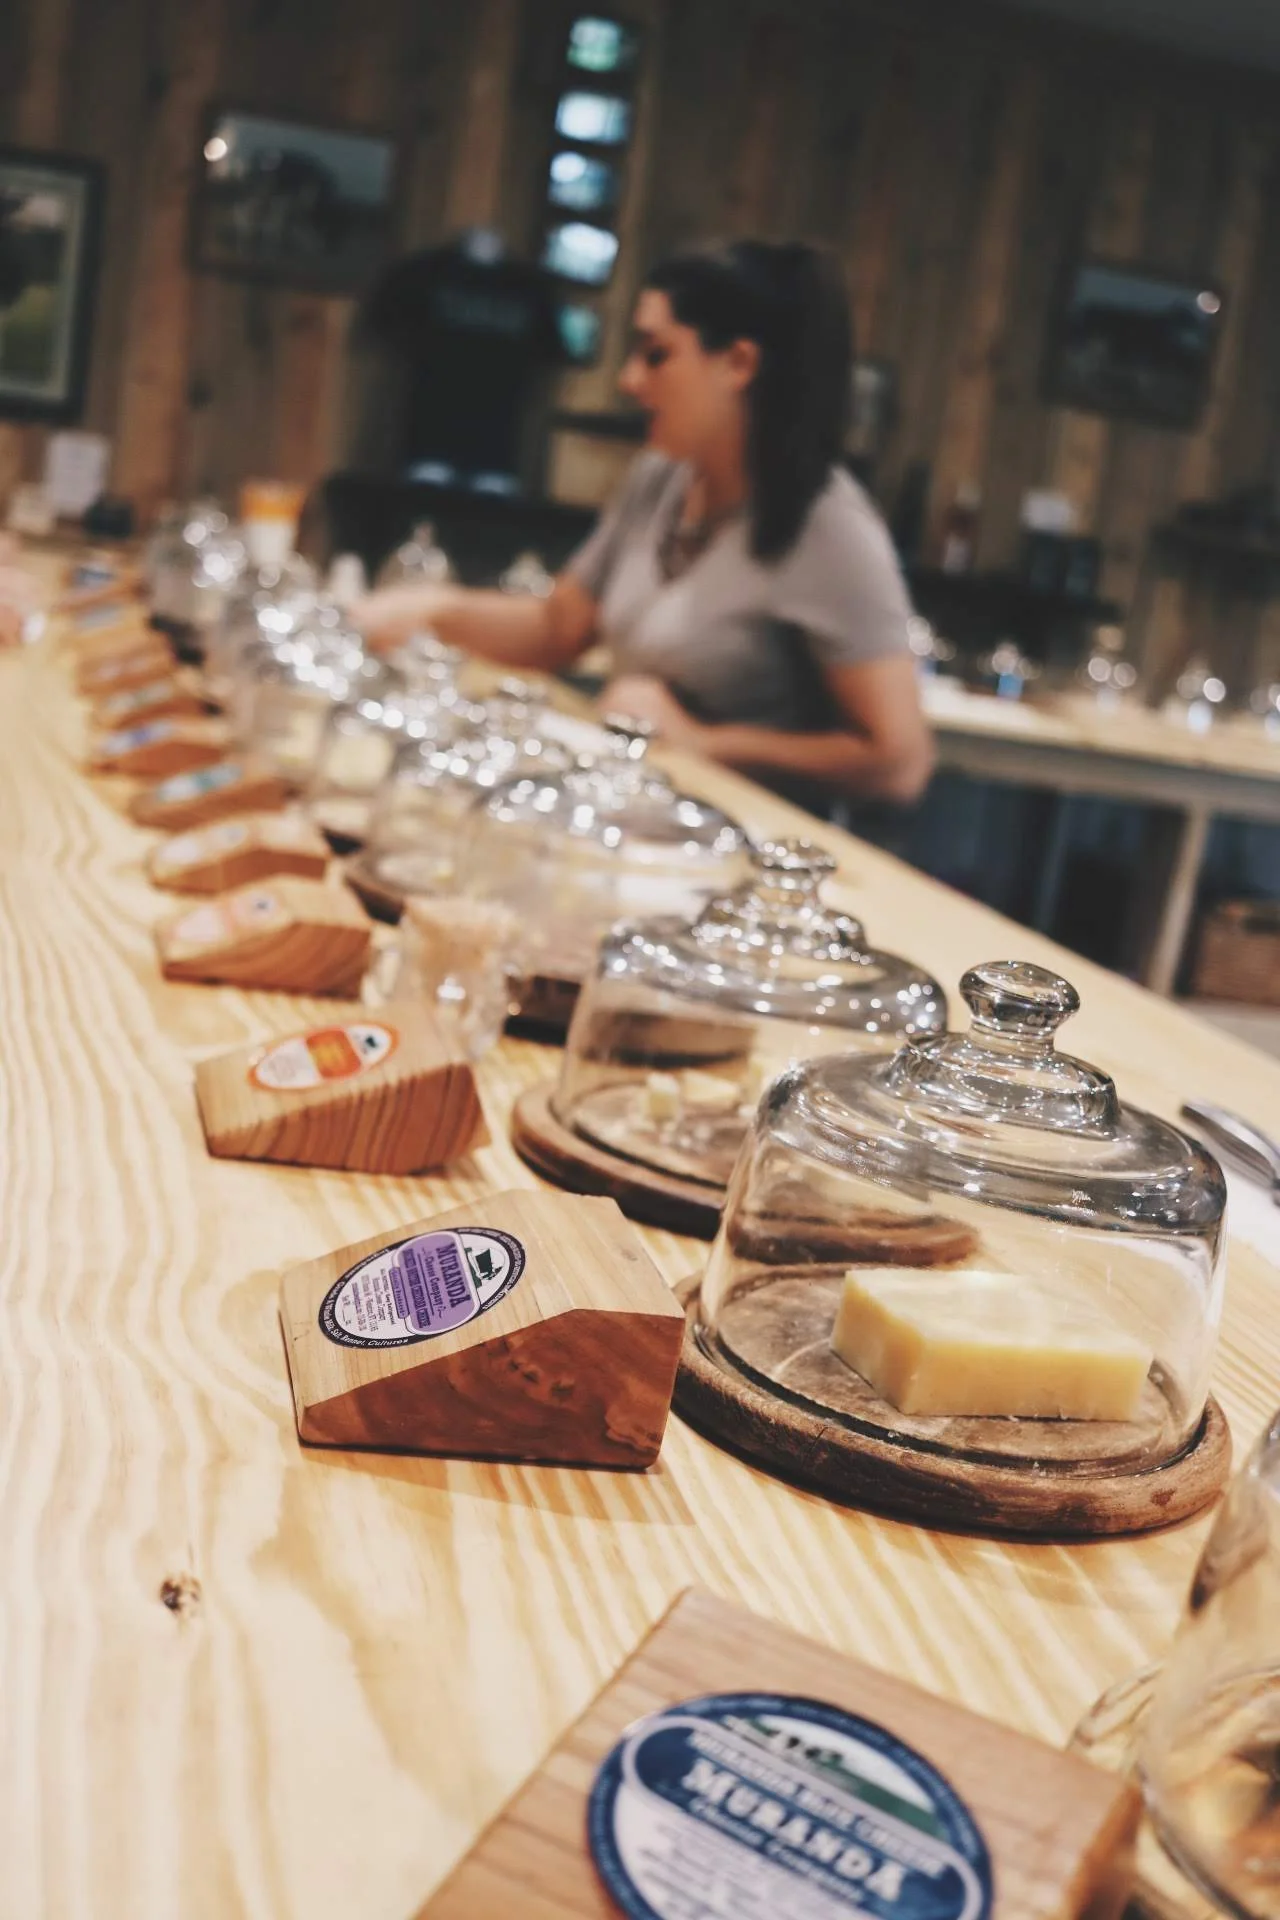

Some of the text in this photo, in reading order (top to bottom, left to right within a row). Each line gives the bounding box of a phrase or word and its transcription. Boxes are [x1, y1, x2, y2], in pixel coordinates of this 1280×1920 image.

[430, 1277, 443, 1306] Company
[436, 1243, 472, 1308] MURANDA
[682, 1759, 906, 1900] MURANDA
